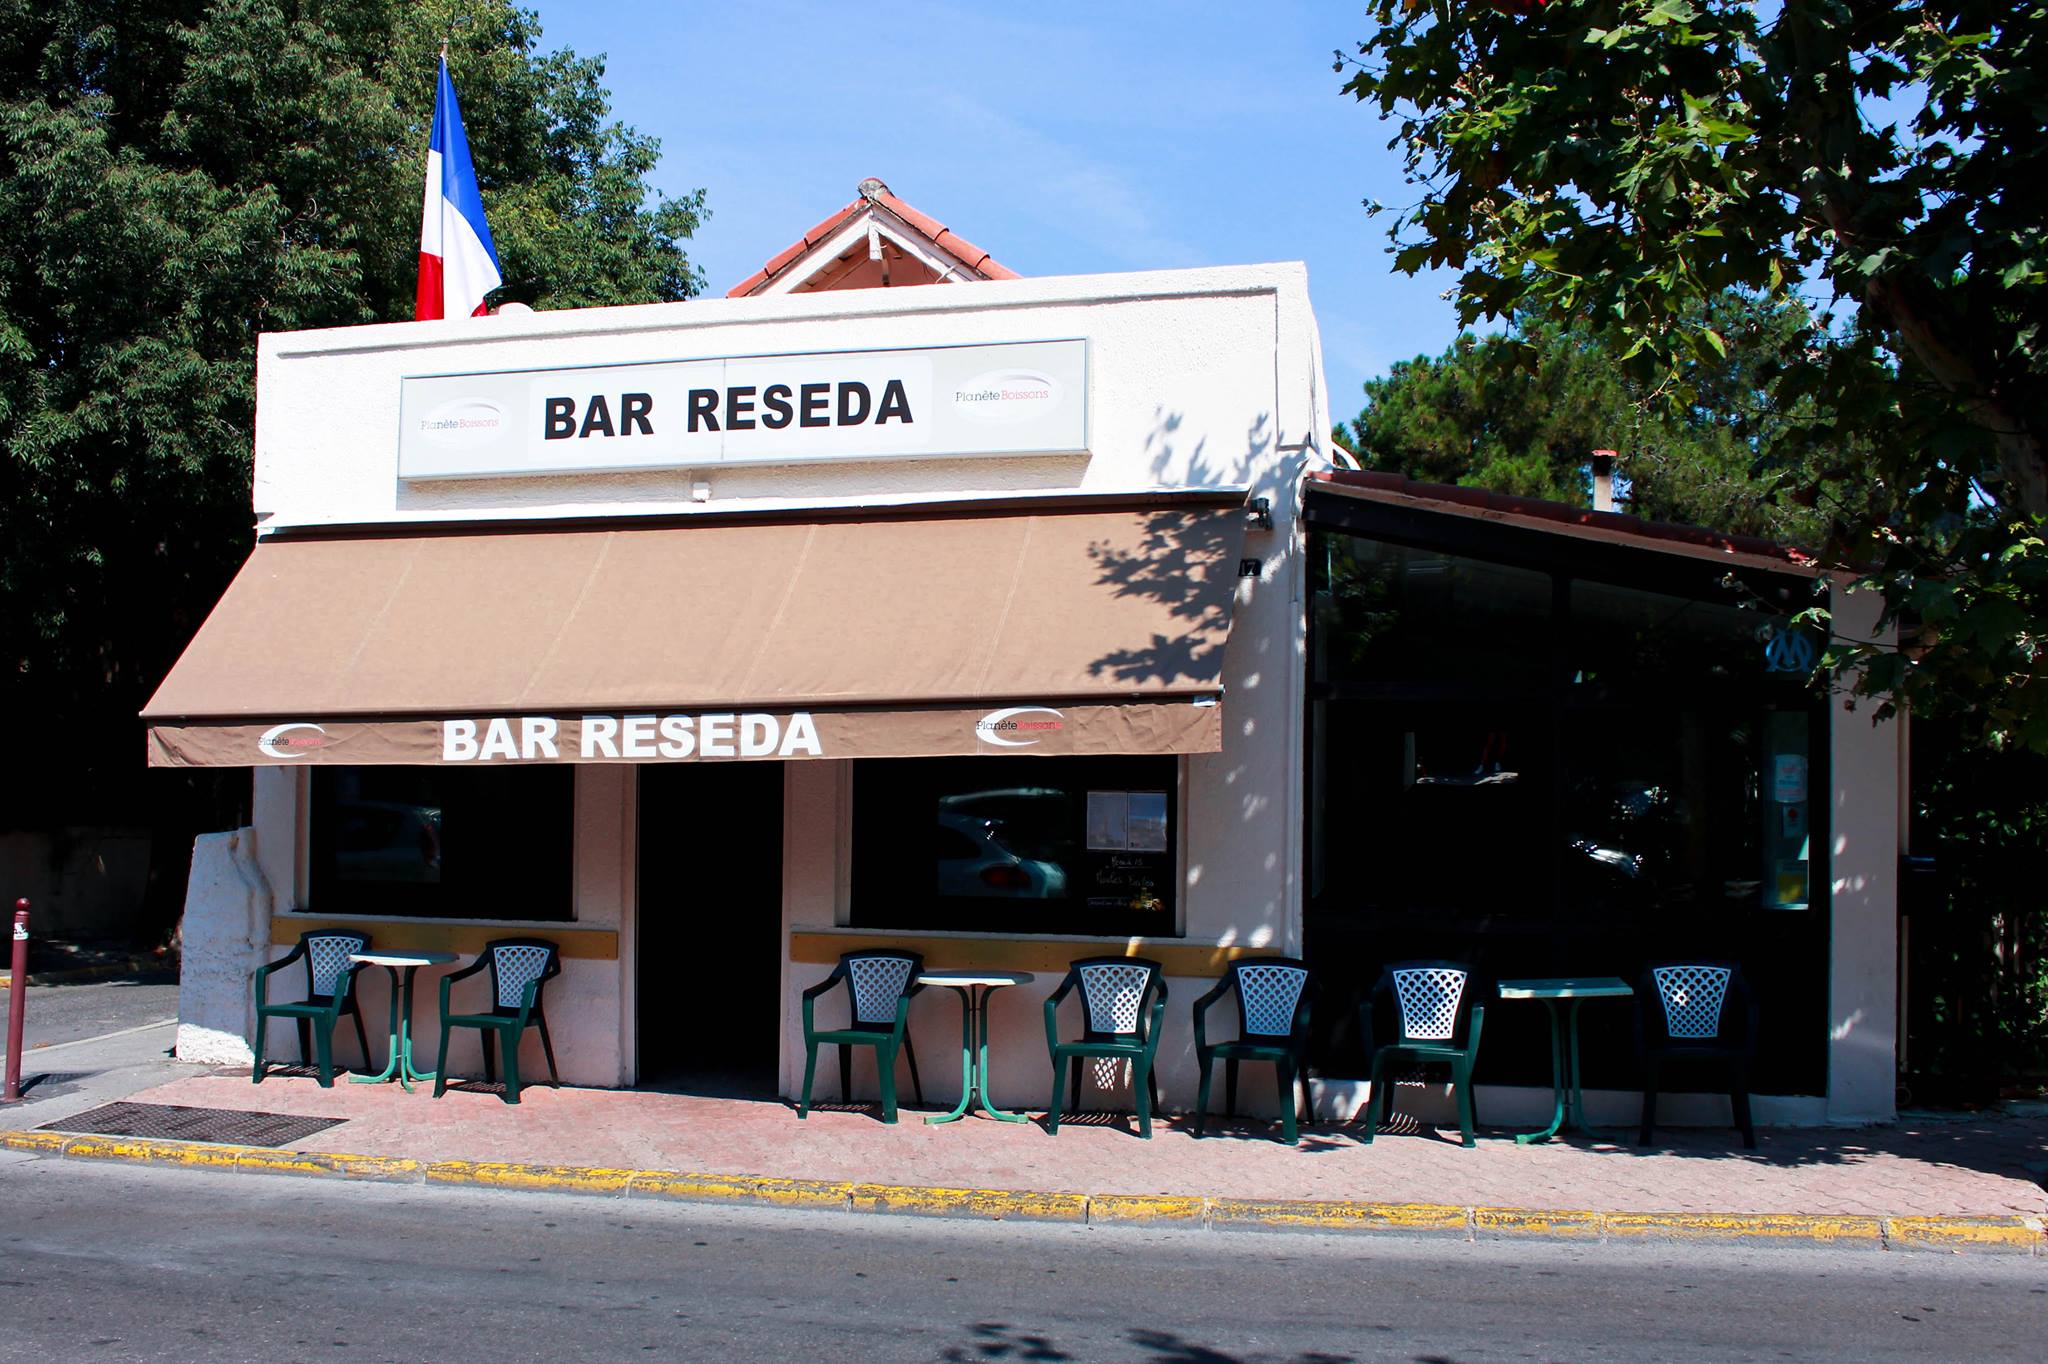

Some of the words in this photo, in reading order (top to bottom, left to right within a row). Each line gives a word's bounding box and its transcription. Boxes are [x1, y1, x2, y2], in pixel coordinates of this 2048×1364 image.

[545, 393, 654, 440] BAR
[687, 379, 914, 433] RESEDA
[443, 716, 560, 761] BAR
[580, 711, 823, 758] RESEDA
